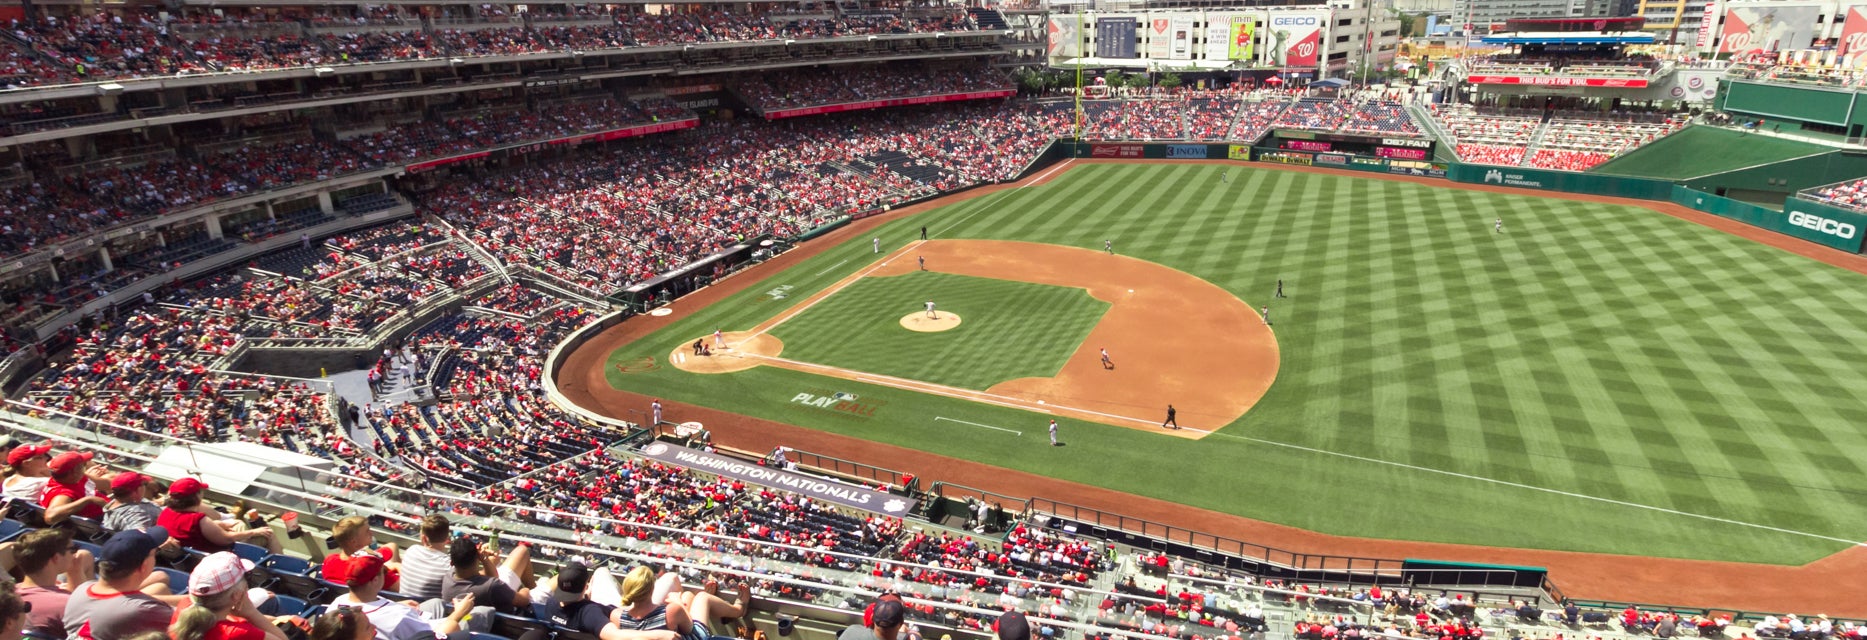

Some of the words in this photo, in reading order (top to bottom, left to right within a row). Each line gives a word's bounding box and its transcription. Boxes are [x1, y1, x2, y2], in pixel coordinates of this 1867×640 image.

[1274, 17, 1316, 26] GEICO
[1535, 77, 1556, 85] BUD'S
[1407, 140, 1431, 148] FAN
[1176, 146, 1206, 156] INOVA
[1788, 210, 1856, 239] GEICO
[790, 392, 839, 408] PLAY
[833, 400, 877, 417] BALL
[675, 450, 777, 485] WASHINGTON
[776, 474, 872, 504] NATIONALS
